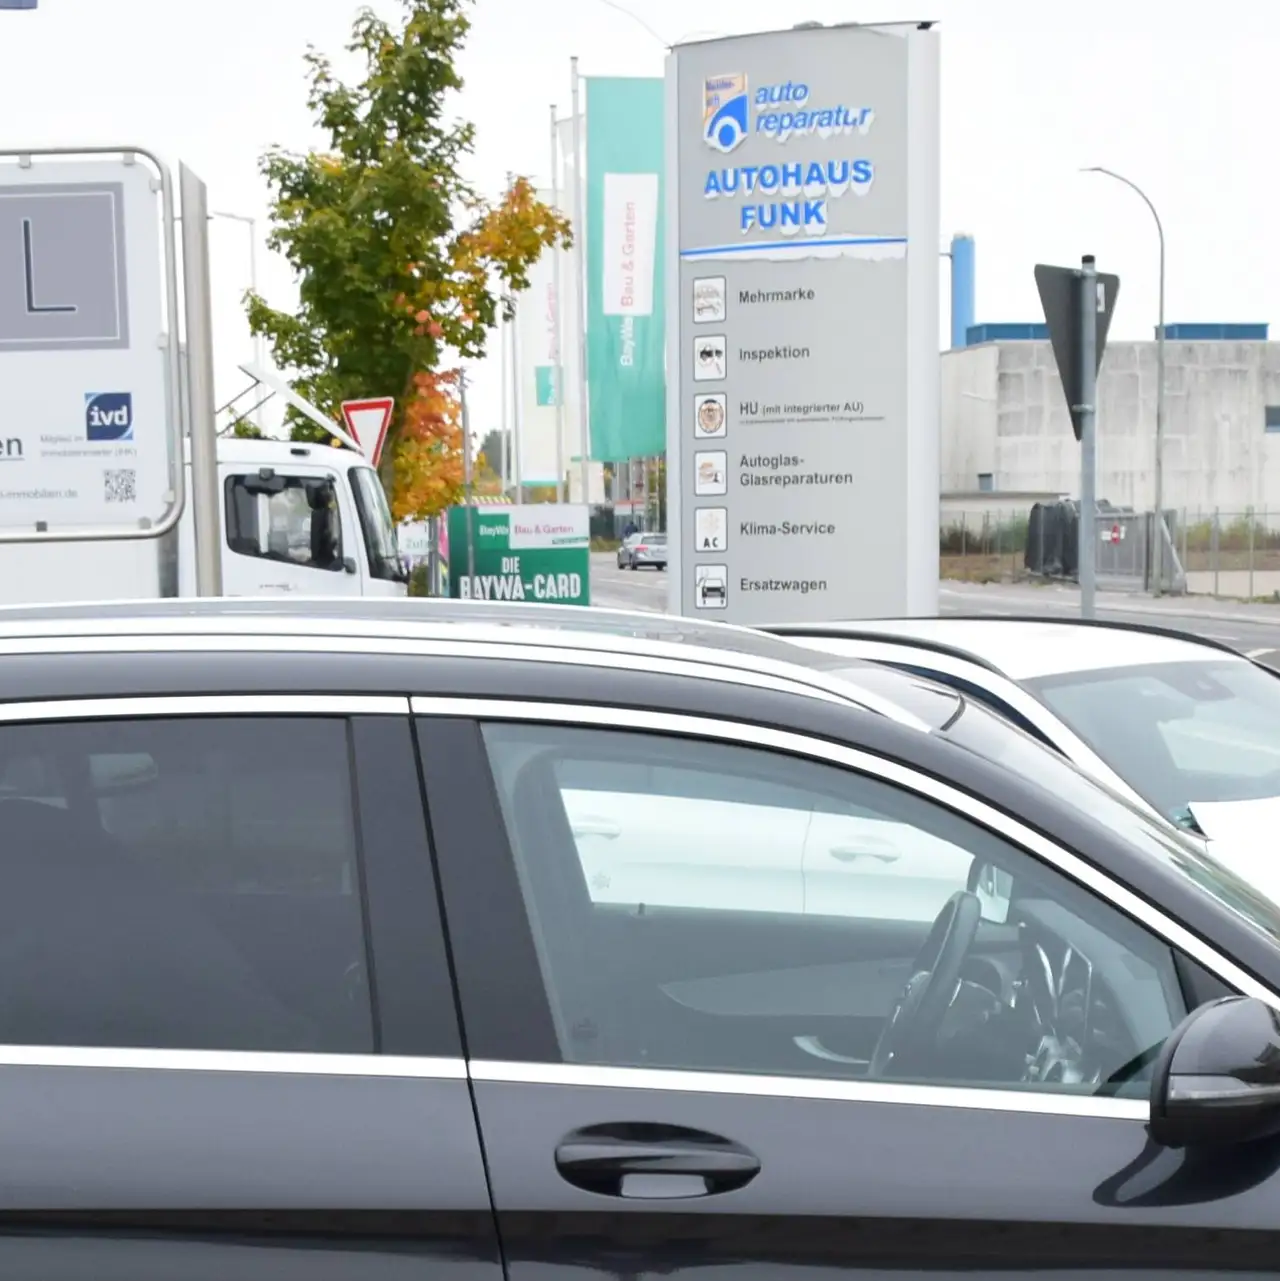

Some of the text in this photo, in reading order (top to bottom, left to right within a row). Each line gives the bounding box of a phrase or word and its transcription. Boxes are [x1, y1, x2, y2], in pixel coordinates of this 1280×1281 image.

[755, 80, 808, 106] auto
[755, 105, 872, 137] reparatur
[704, 159, 872, 194] AUTOHAUS
[741, 200, 825, 230] FUNK
[22, 218, 78, 313] L
[739, 288, 814, 303] Mehrmarke
[740, 346, 809, 363] Inspektion
[90, 404, 129, 426] ivd
[740, 454, 804, 470] Autoglas-
[740, 473, 852, 488] Glasreparaturen
[544, 525, 574, 534] Garten
[740, 521, 835, 535] Klima-Service
[501, 556, 520, 574] DIE
[459, 573, 582, 600] BAYWA-CARD
[740, 578, 826, 594] Ersatzwagen
